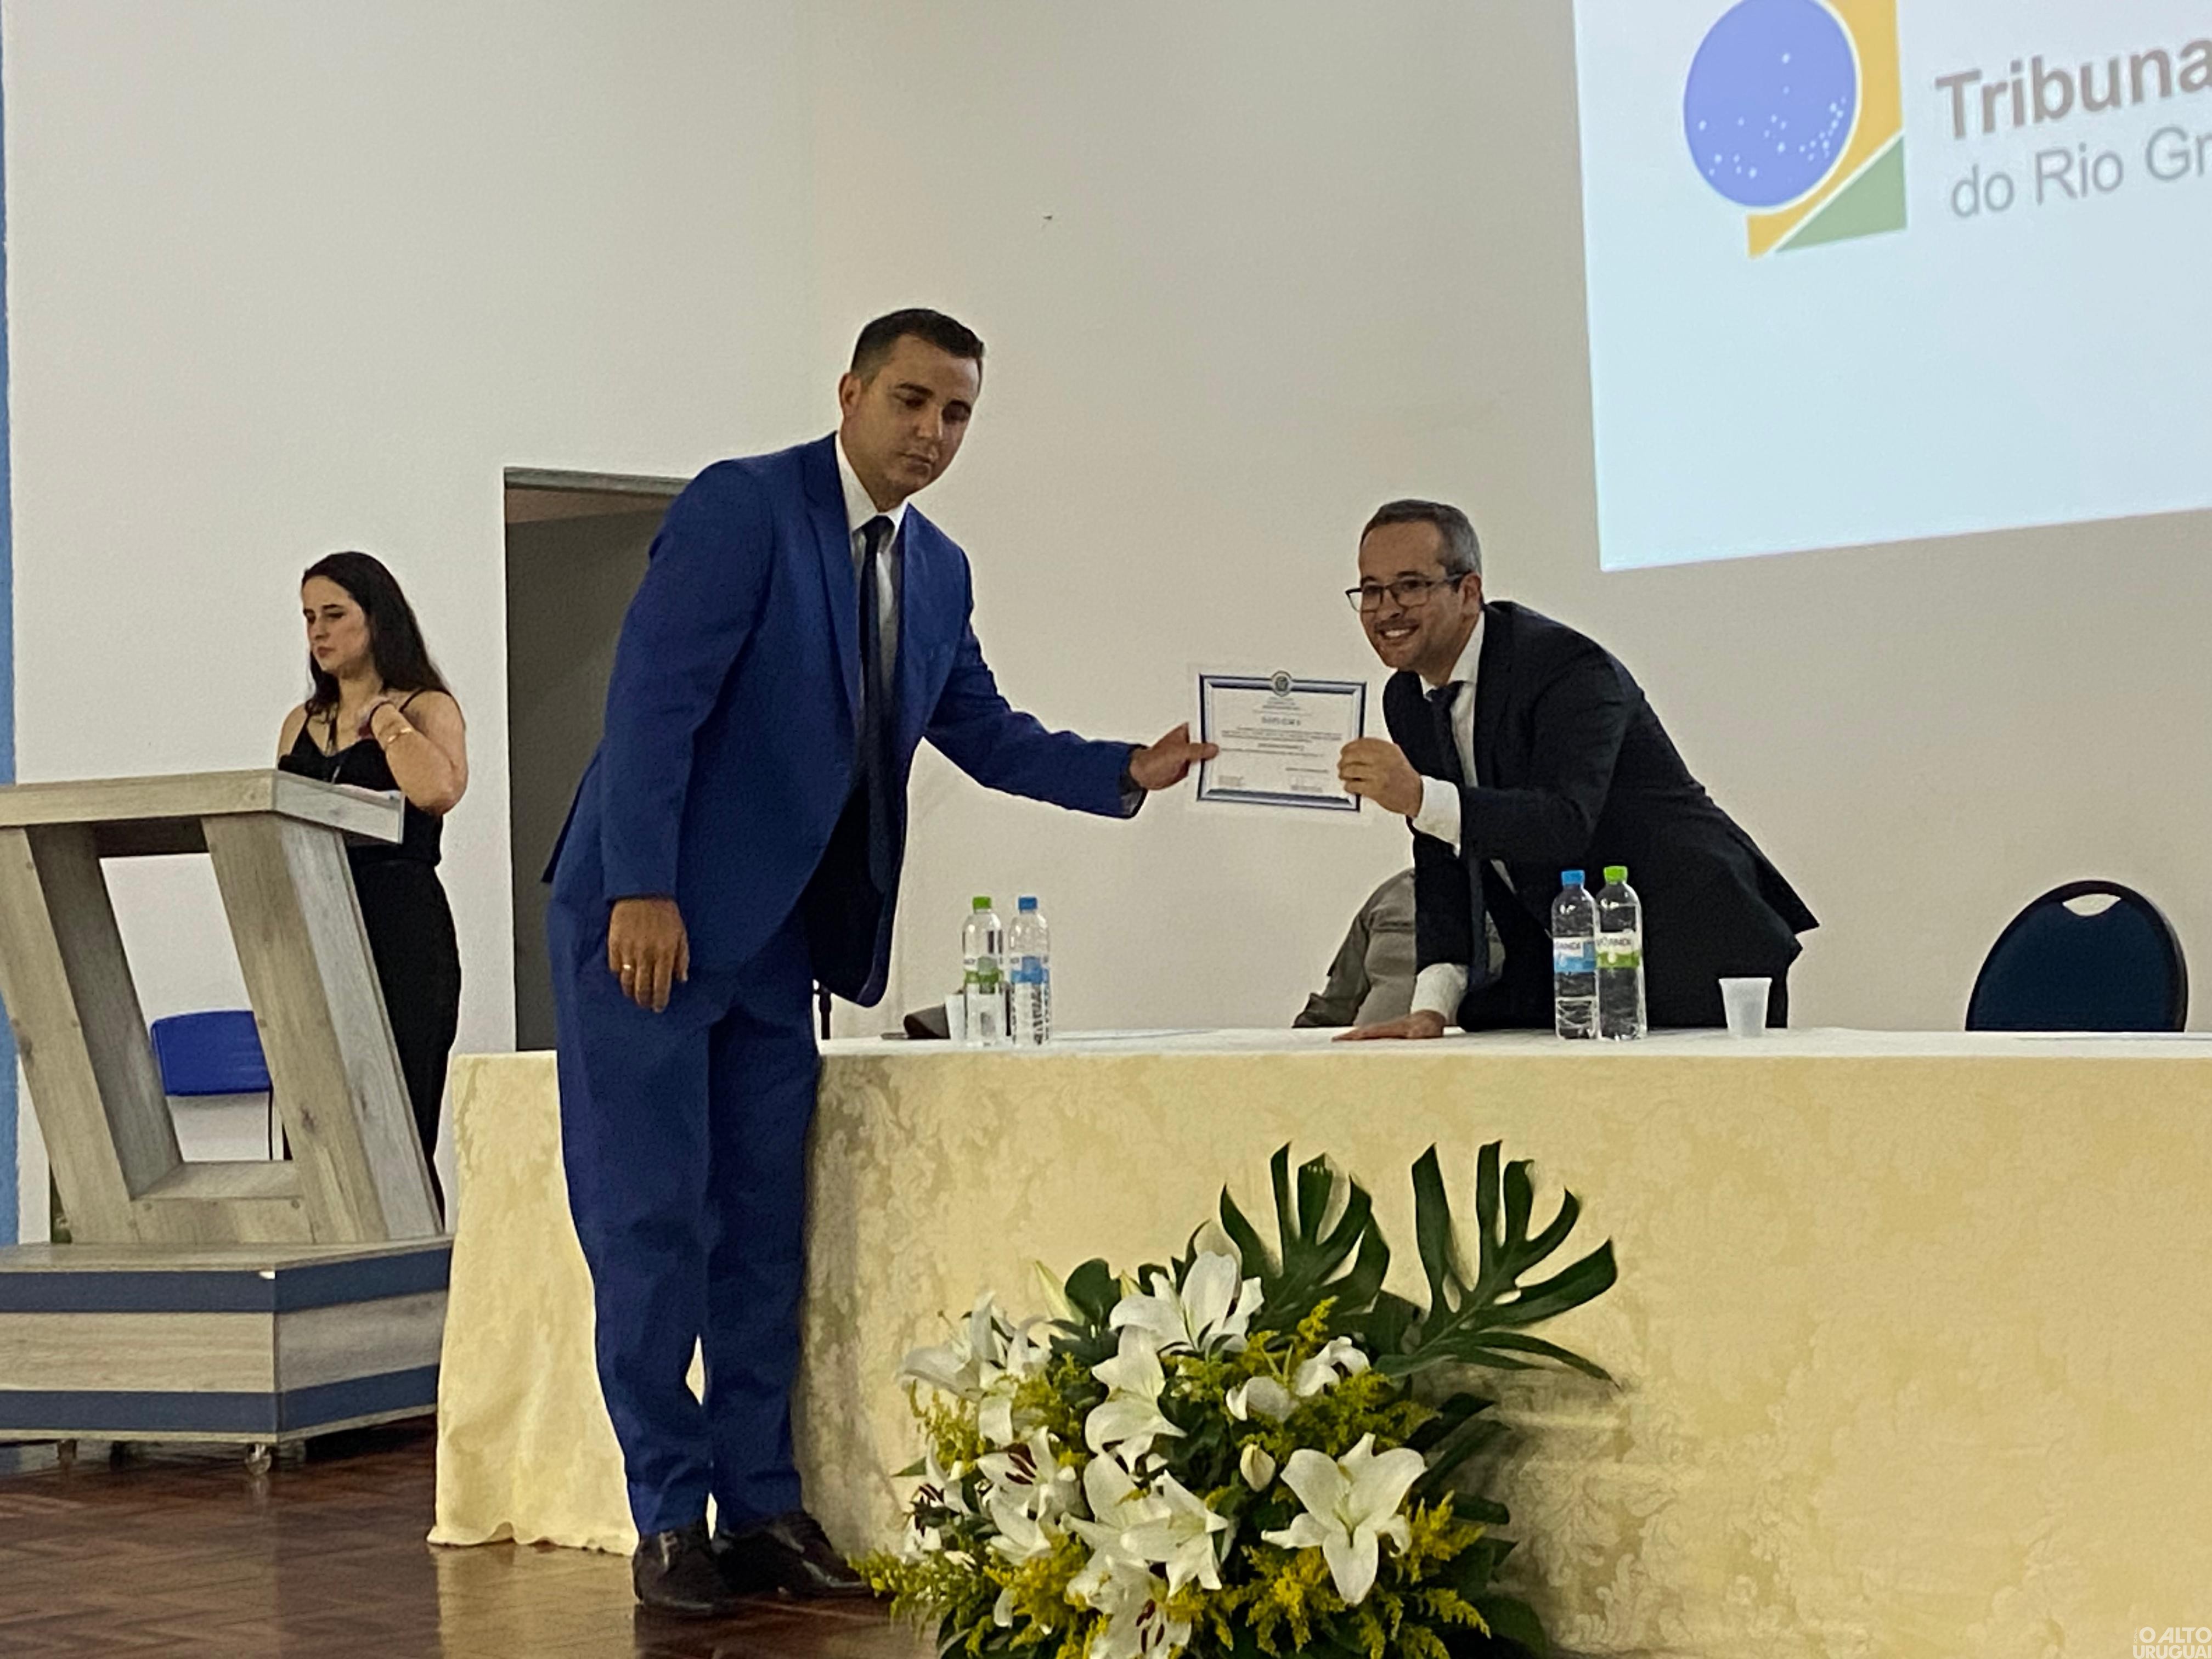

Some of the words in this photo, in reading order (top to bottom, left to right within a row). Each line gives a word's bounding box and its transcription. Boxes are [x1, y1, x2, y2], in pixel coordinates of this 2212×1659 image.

[1935, 38, 2212, 139] Tribuna
[1951, 164, 2015, 217] do
[2036, 142, 2123, 205] Rio
